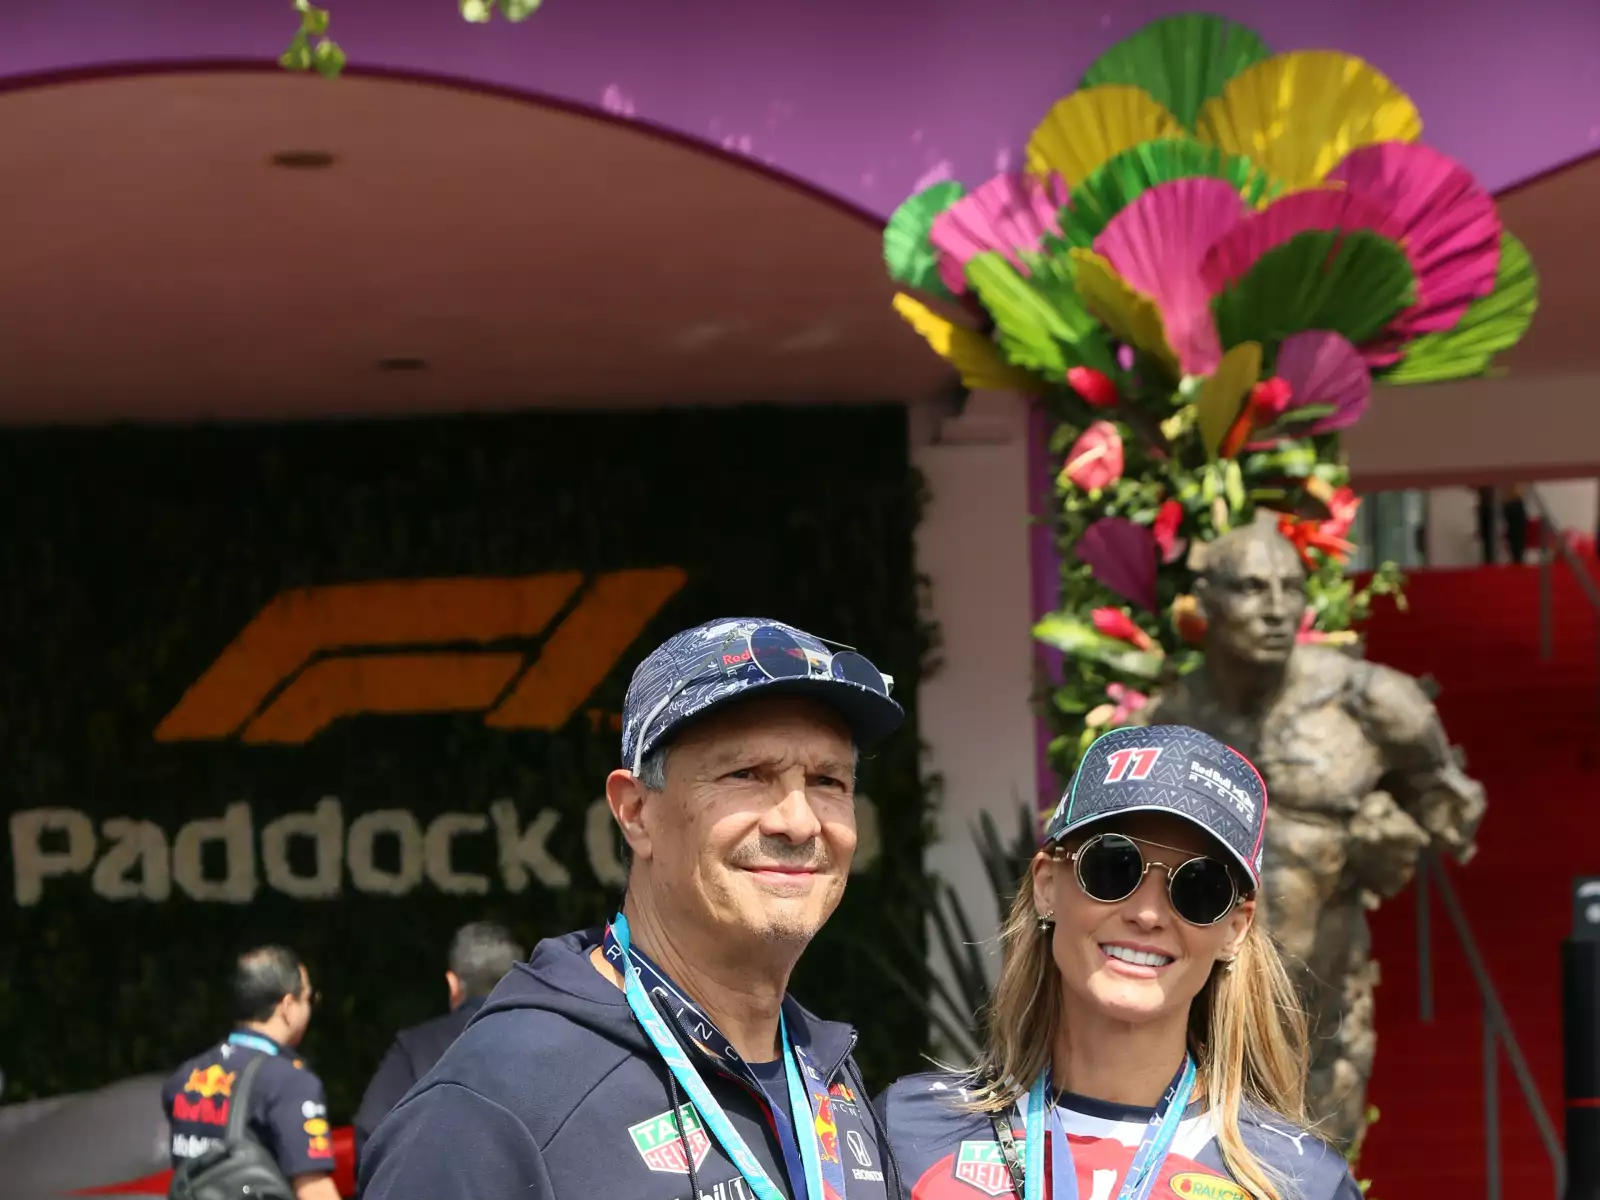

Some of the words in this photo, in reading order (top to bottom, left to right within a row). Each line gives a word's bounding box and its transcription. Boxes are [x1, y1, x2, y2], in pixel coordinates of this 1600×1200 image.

[1103, 746, 1163, 785] 11
[1188, 772, 1254, 824] RACING
[9, 795, 570, 906] Paddock
